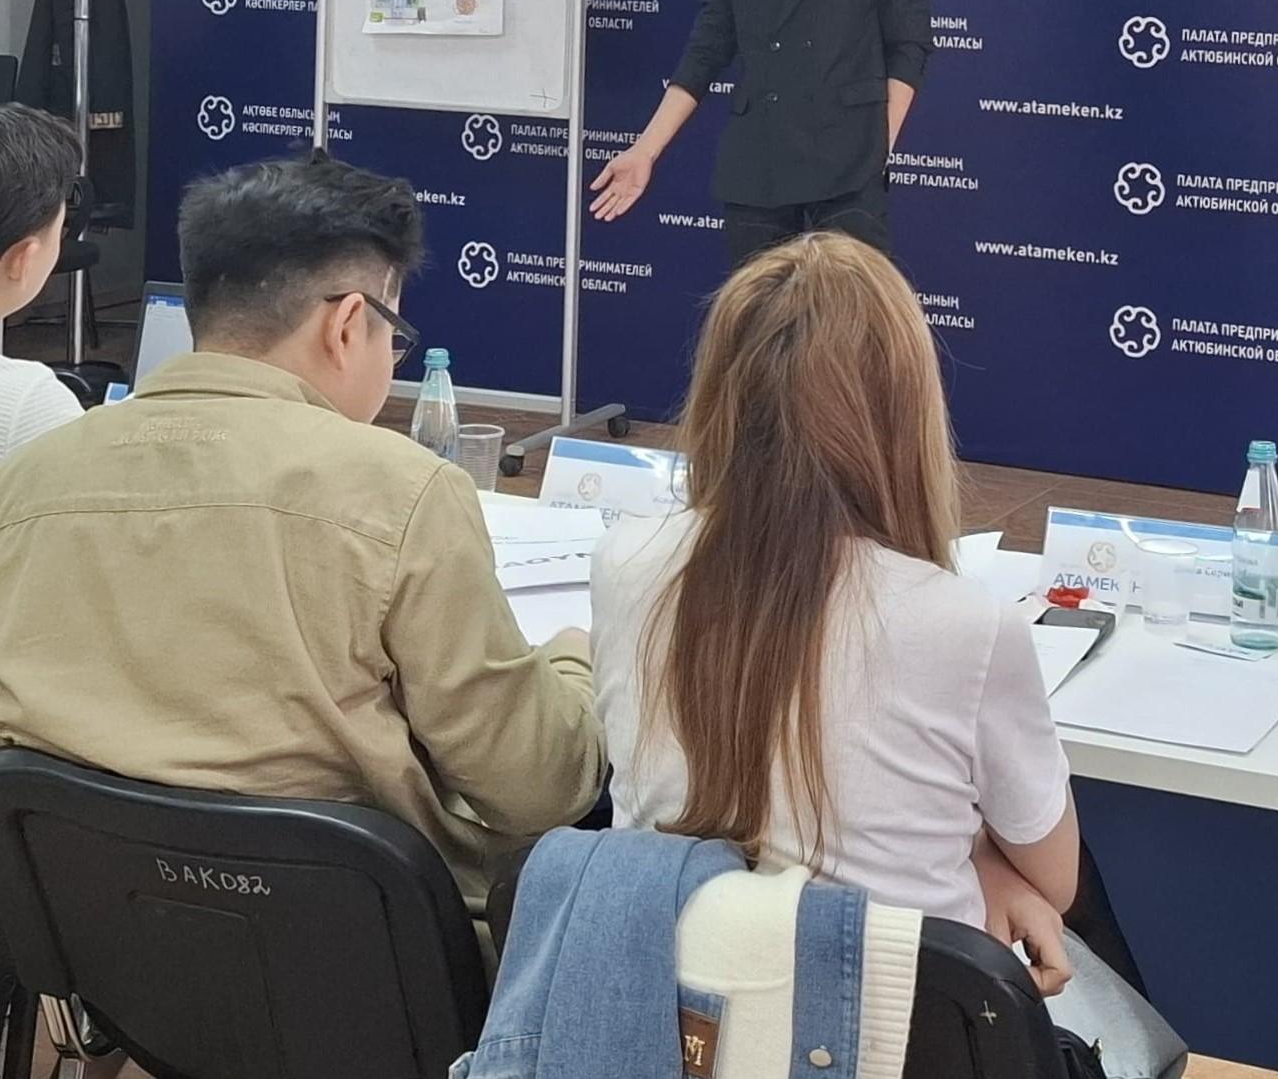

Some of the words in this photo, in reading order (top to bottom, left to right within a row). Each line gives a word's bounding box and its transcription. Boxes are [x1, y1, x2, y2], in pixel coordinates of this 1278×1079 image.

[588, 17, 633, 30] ОБЛАСТИ
[1181, 28, 1228, 43] ПАЛАТА
[1180, 49, 1274, 67] АКТЮБИНСКОЙ
[979, 98, 1123, 120] www.atameken.kz
[511, 123, 548, 137] ПАЛАТА
[510, 142, 569, 158] АКТЮБИНСК
[919, 174, 979, 190] ПАЛАТАСЫ
[1176, 174, 1223, 190] ПАЛАТА
[1175, 195, 1269, 214] АКТЮБИНСКОЙ
[507, 252, 544, 267] ПАЛАТА
[975, 240, 1119, 265] www.atameken.kz
[506, 270, 566, 287] АКТЮБИНСК
[581, 277, 627, 293] ОБЛАСТИ
[1172, 318, 1219, 335] ПАЛАТА
[1171, 339, 1264, 361] АКТЮБИНСКОЙ
